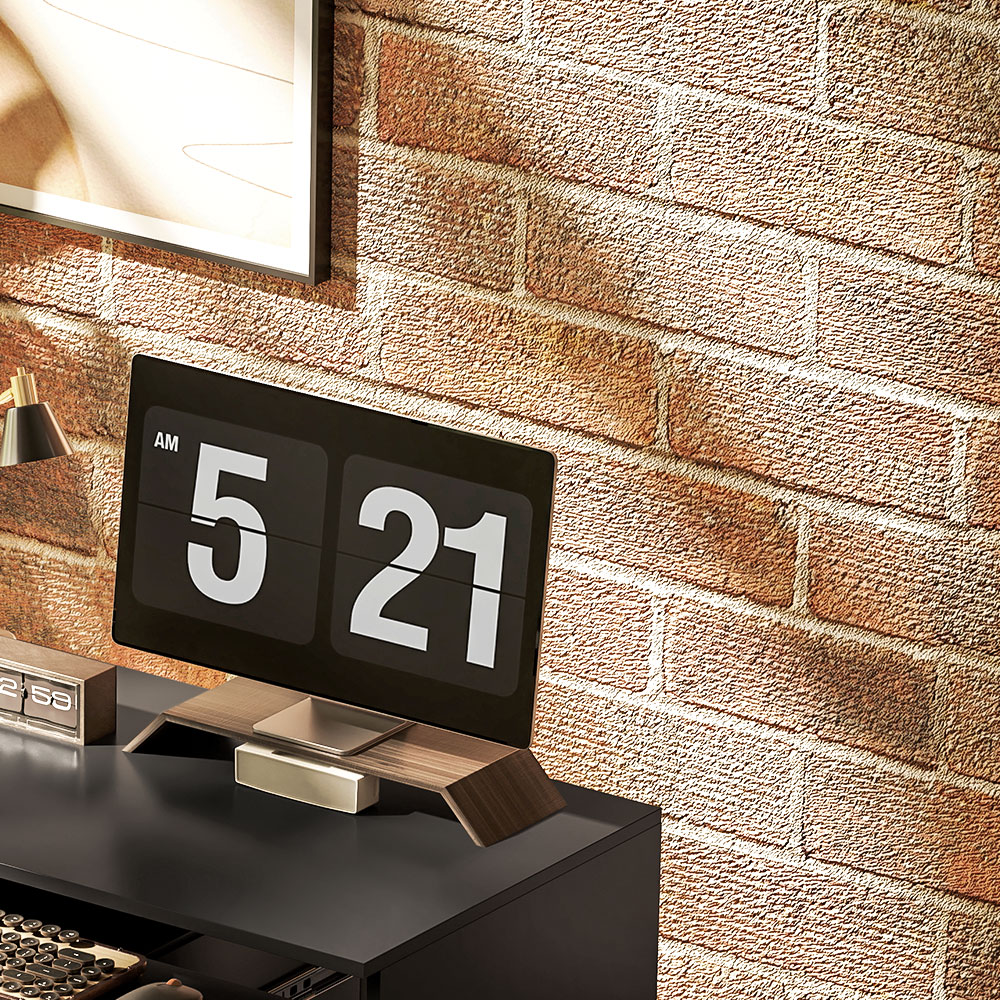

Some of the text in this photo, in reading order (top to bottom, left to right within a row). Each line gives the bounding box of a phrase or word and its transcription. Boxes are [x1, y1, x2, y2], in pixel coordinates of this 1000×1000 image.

[154, 431, 179, 453] AM
[187, 442, 508, 669] 5 21
[31, 684, 72, 711] 59
